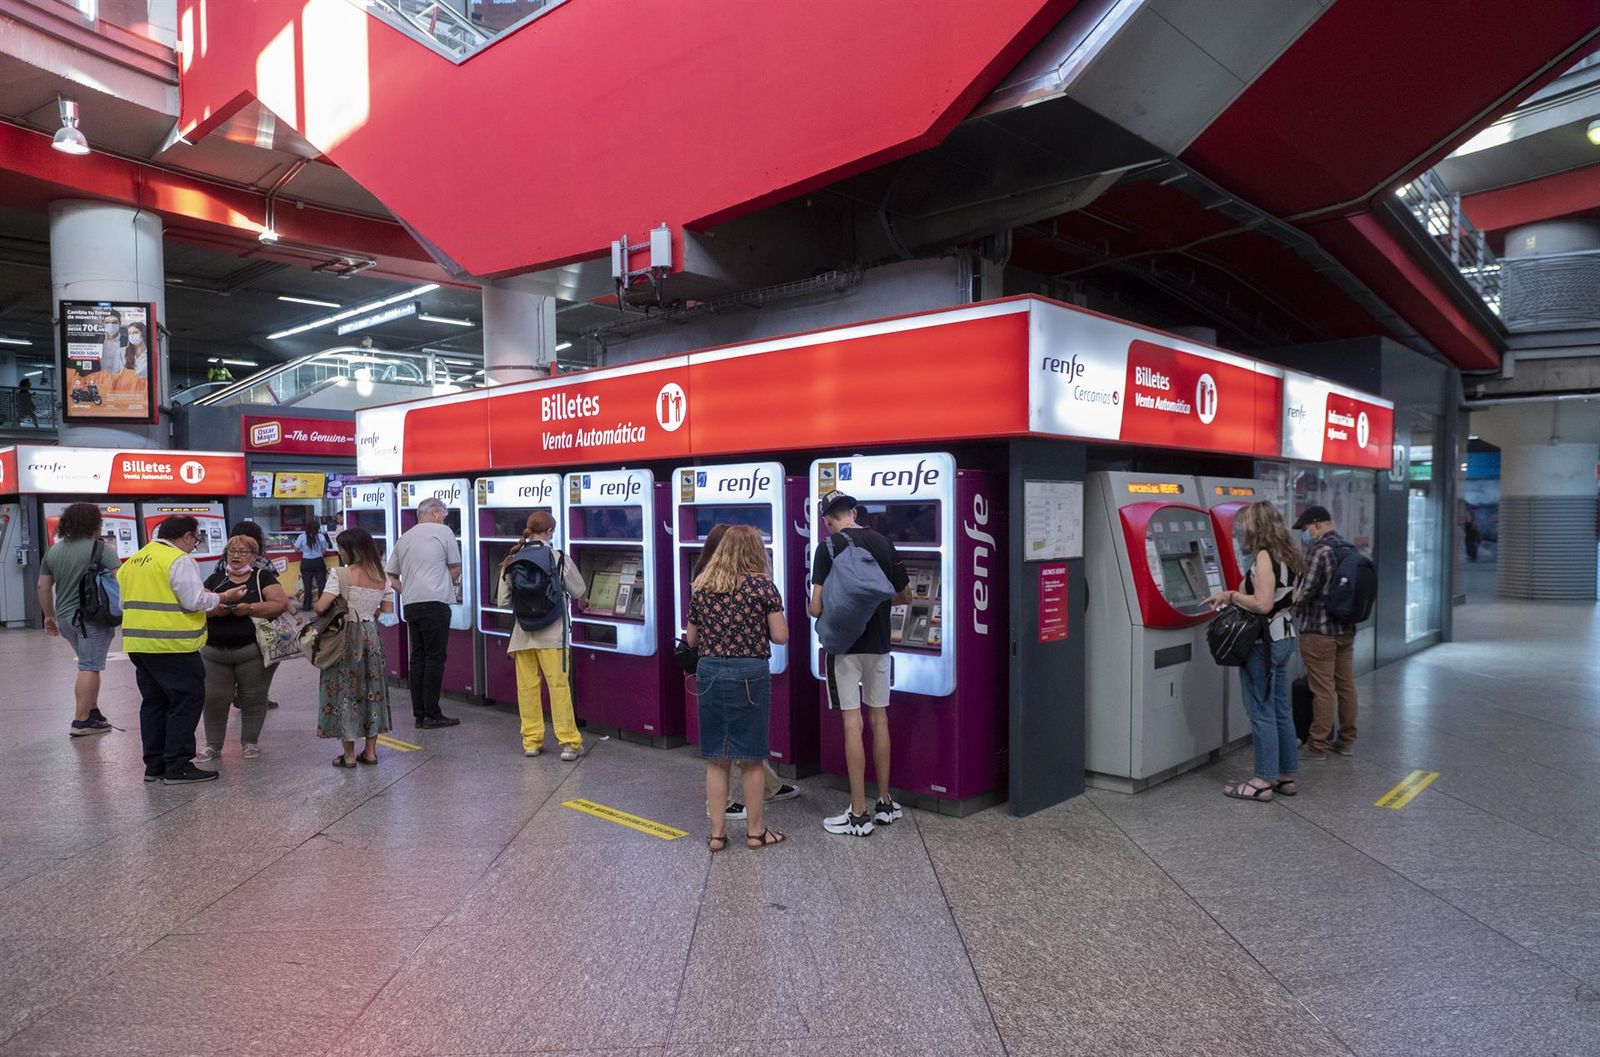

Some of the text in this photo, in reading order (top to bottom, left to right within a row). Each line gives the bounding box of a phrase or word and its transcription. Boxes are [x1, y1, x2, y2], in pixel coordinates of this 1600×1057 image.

[1042, 354, 1085, 383] renfe
[1135, 366, 1170, 390] Billetes
[541, 392, 600, 422] Billetes
[1135, 392, 1155, 409] Venta
[257, 427, 275, 435] Oscar
[257, 433, 277, 442] Mayer
[292, 430, 346, 443] The Genuine
[360, 432, 379, 448] renfe
[541, 422, 646, 450] Venta Automática
[122, 460, 172, 473] Billetes
[870, 460, 940, 495] renfe
[433, 483, 461, 505] renfe
[518, 479, 552, 504] renfe
[600, 474, 641, 502] renfe
[718, 468, 771, 499] renfe
[362, 487, 385, 507] renfe
[130, 554, 152, 567] renfe
[964, 493, 996, 635] renfe
